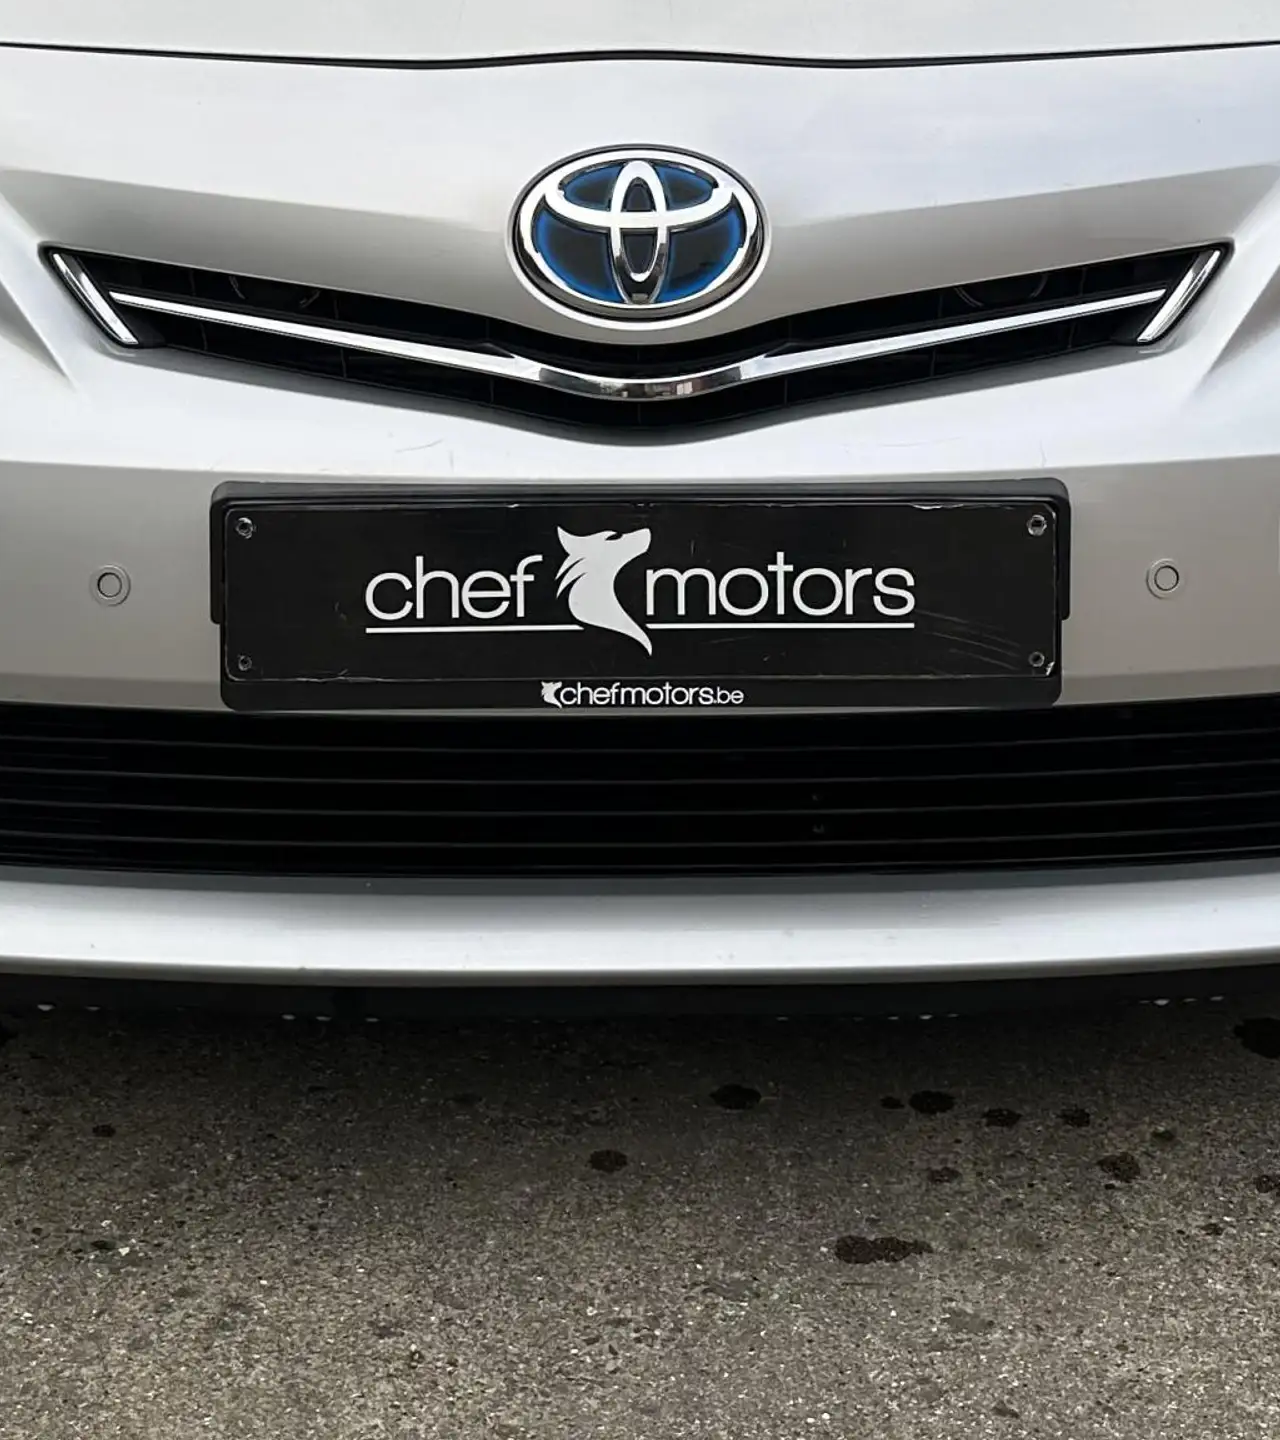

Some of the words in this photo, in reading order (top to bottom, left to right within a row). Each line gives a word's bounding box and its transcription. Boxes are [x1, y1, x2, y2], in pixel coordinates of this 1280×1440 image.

[365, 554, 543, 621] chef
[645, 551, 916, 617] motors
[559, 681, 745, 706] chefmotors.be
